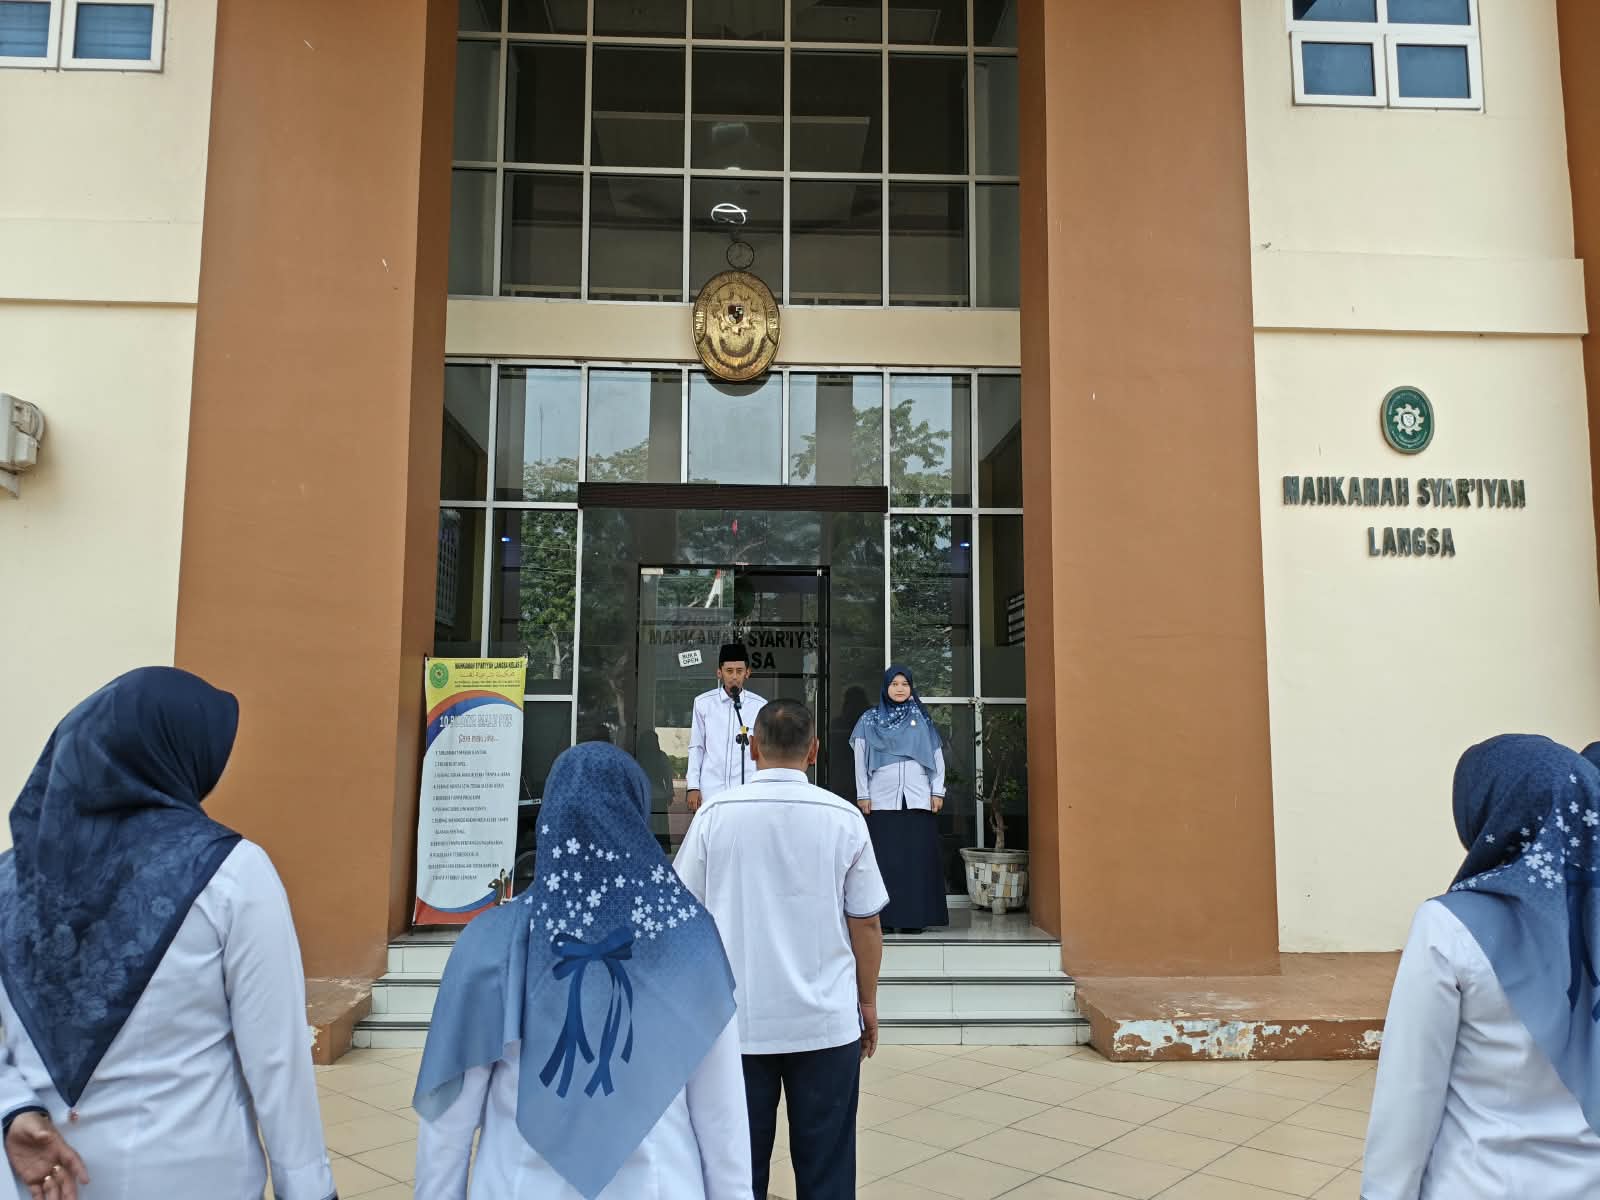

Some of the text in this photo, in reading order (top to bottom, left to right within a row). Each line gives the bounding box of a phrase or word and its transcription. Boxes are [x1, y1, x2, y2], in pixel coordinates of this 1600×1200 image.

[1282, 475, 1526, 508] MAHKAMAH SYAR'IYAH
[1367, 526, 1456, 558] LANGSA
[683, 657, 699, 665] OPEN
